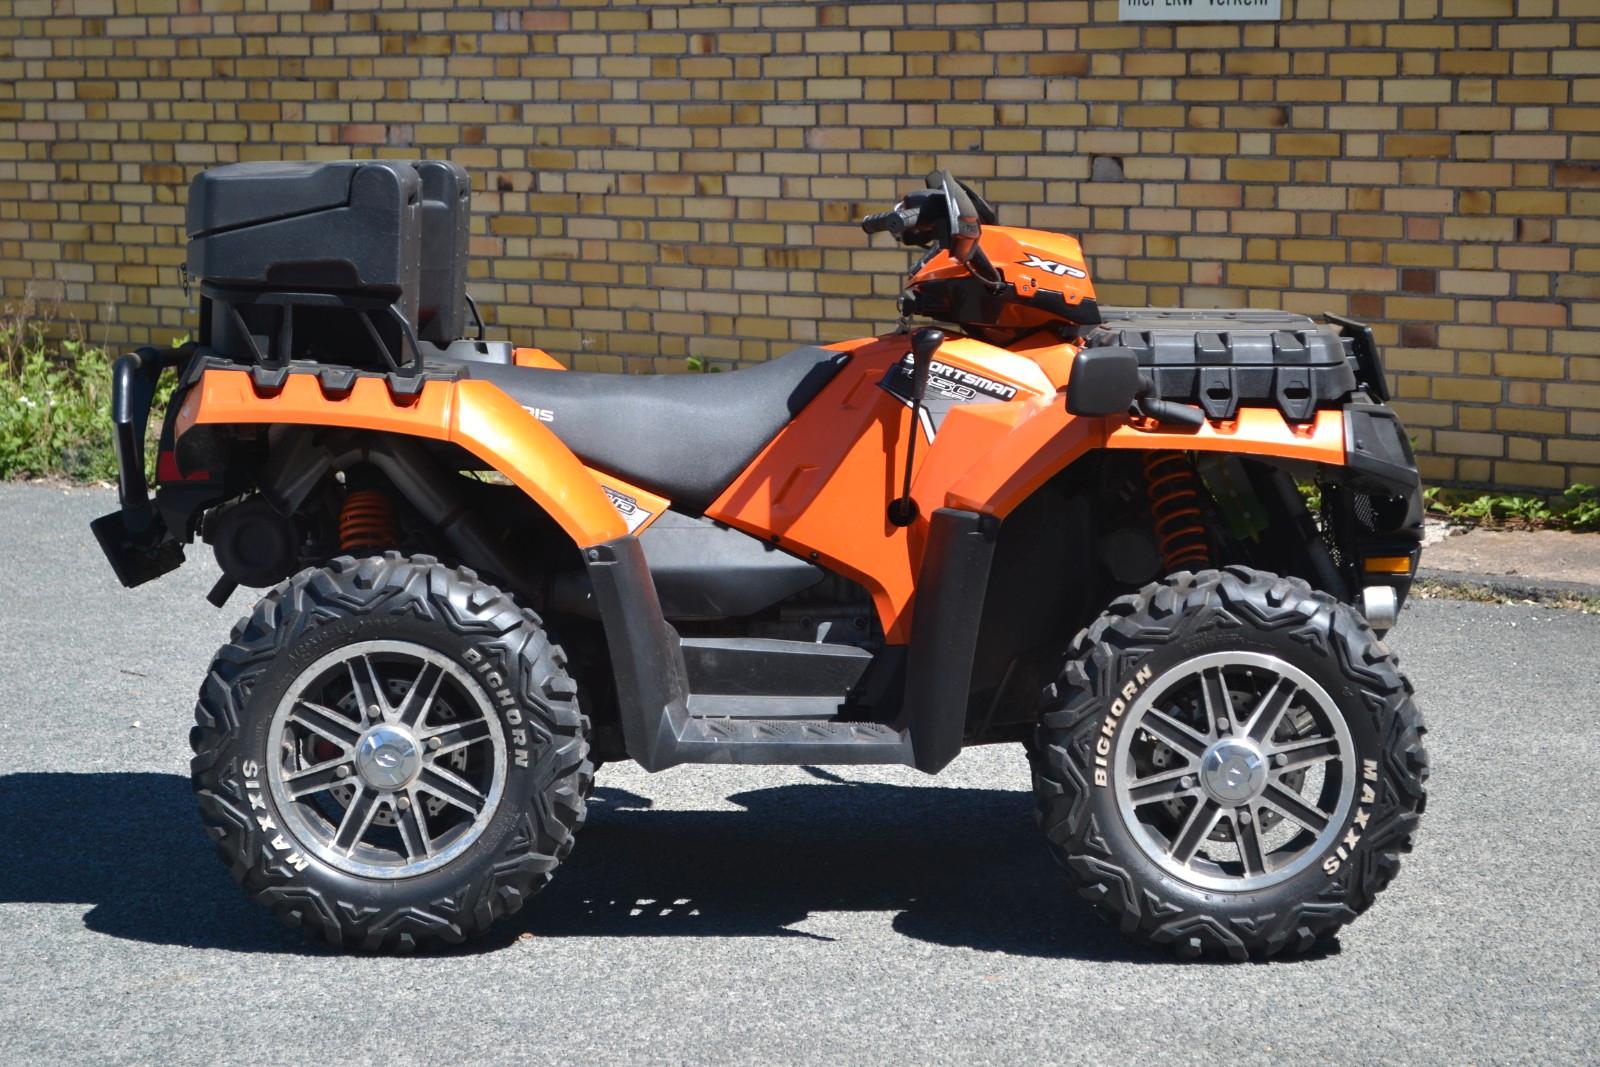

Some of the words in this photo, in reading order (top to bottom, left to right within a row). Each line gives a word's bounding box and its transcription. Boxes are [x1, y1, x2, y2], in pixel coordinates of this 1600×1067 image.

[1017, 253, 1086, 279] XP
[904, 353, 1018, 398] SORTSMAN
[463, 648, 529, 767] BIGHORN
[1094, 665, 1152, 787] BIGHORN
[242, 761, 310, 872] MAXXIS
[1322, 760, 1378, 875] MAXXIS
